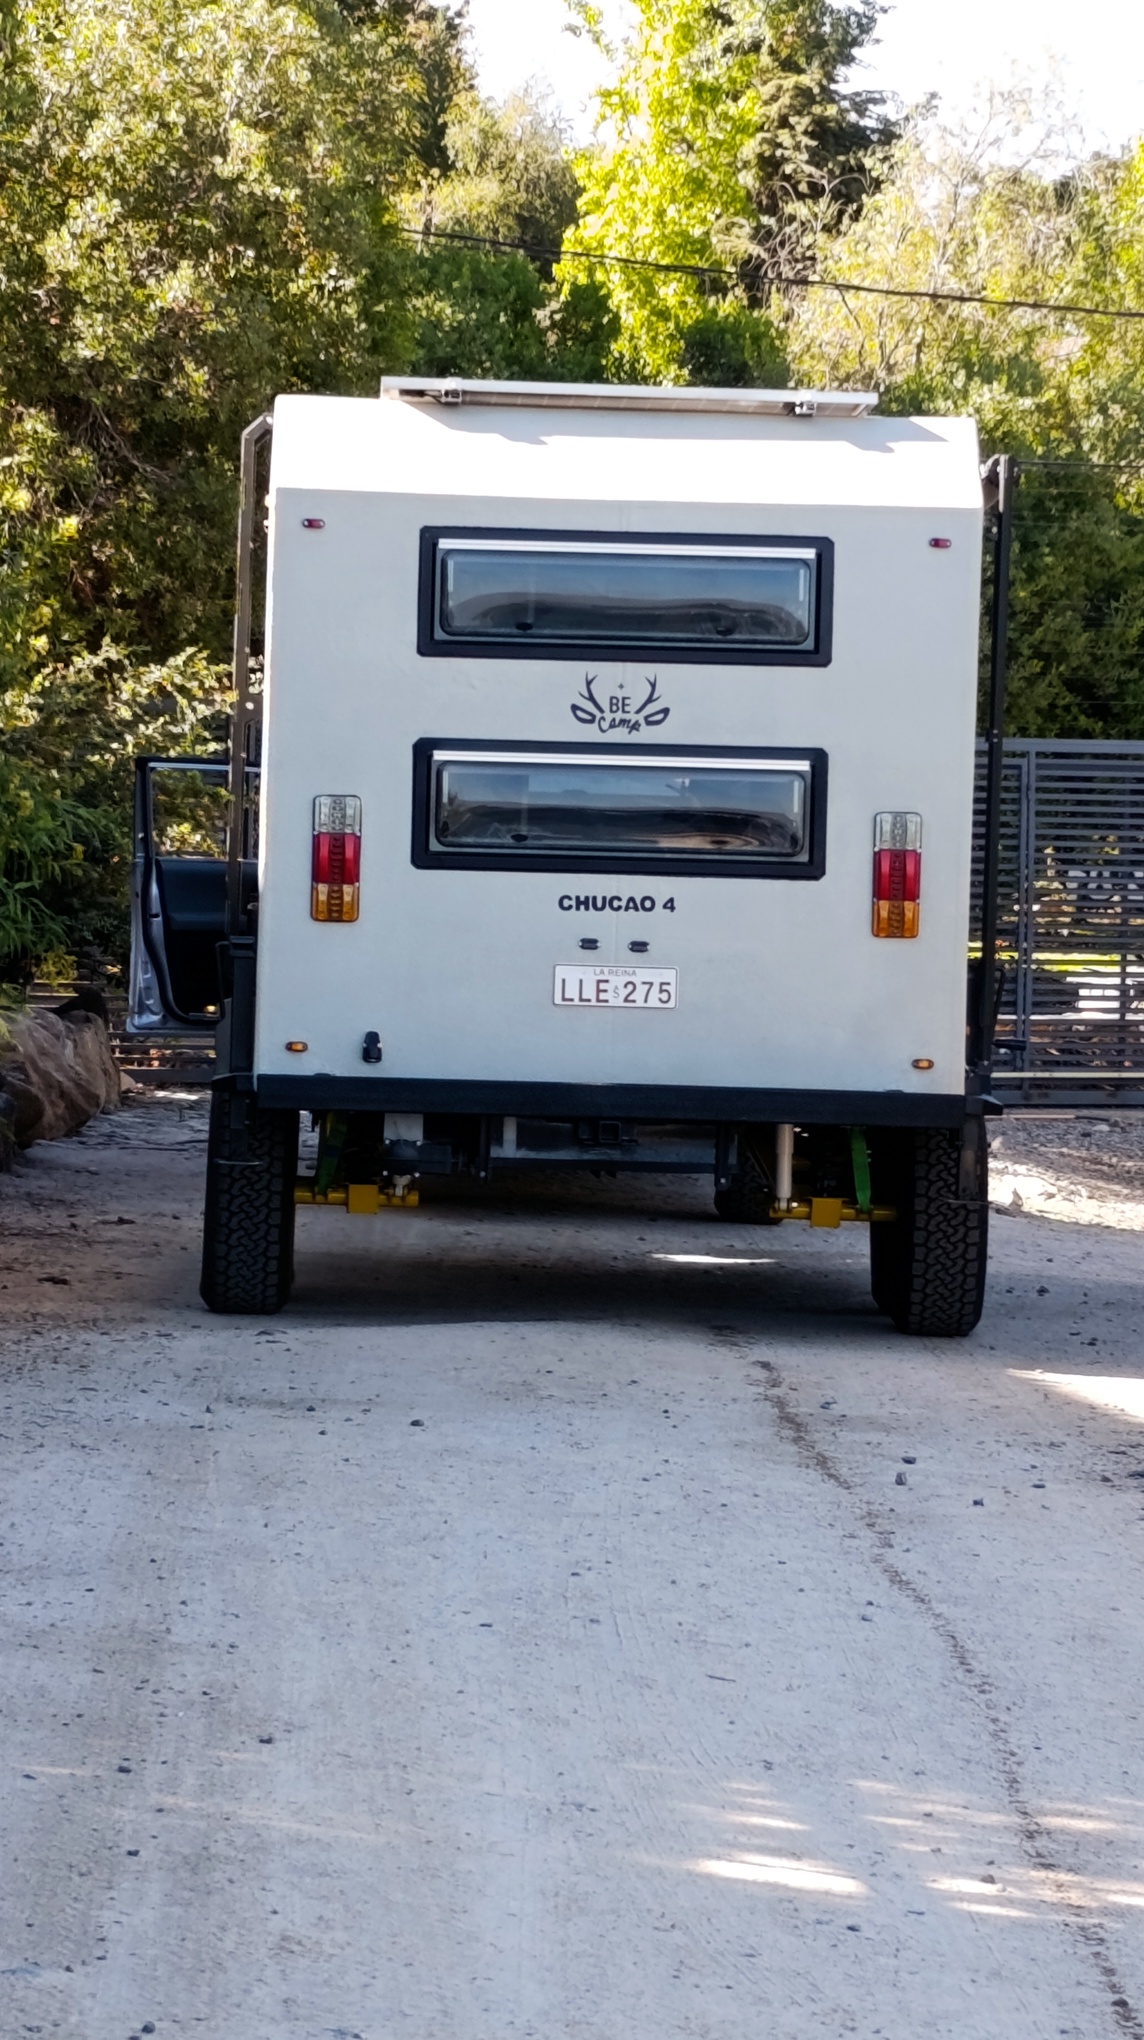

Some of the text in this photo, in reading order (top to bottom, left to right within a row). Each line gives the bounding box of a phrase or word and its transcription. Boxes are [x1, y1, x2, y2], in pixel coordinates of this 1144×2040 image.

[609, 696, 631, 714] BE
[558, 895, 676, 912] CHUCAO 4
[593, 968, 637, 977] LA REINA
[561, 978, 610, 1003] LLE
[623, 981, 672, 1004] 275
